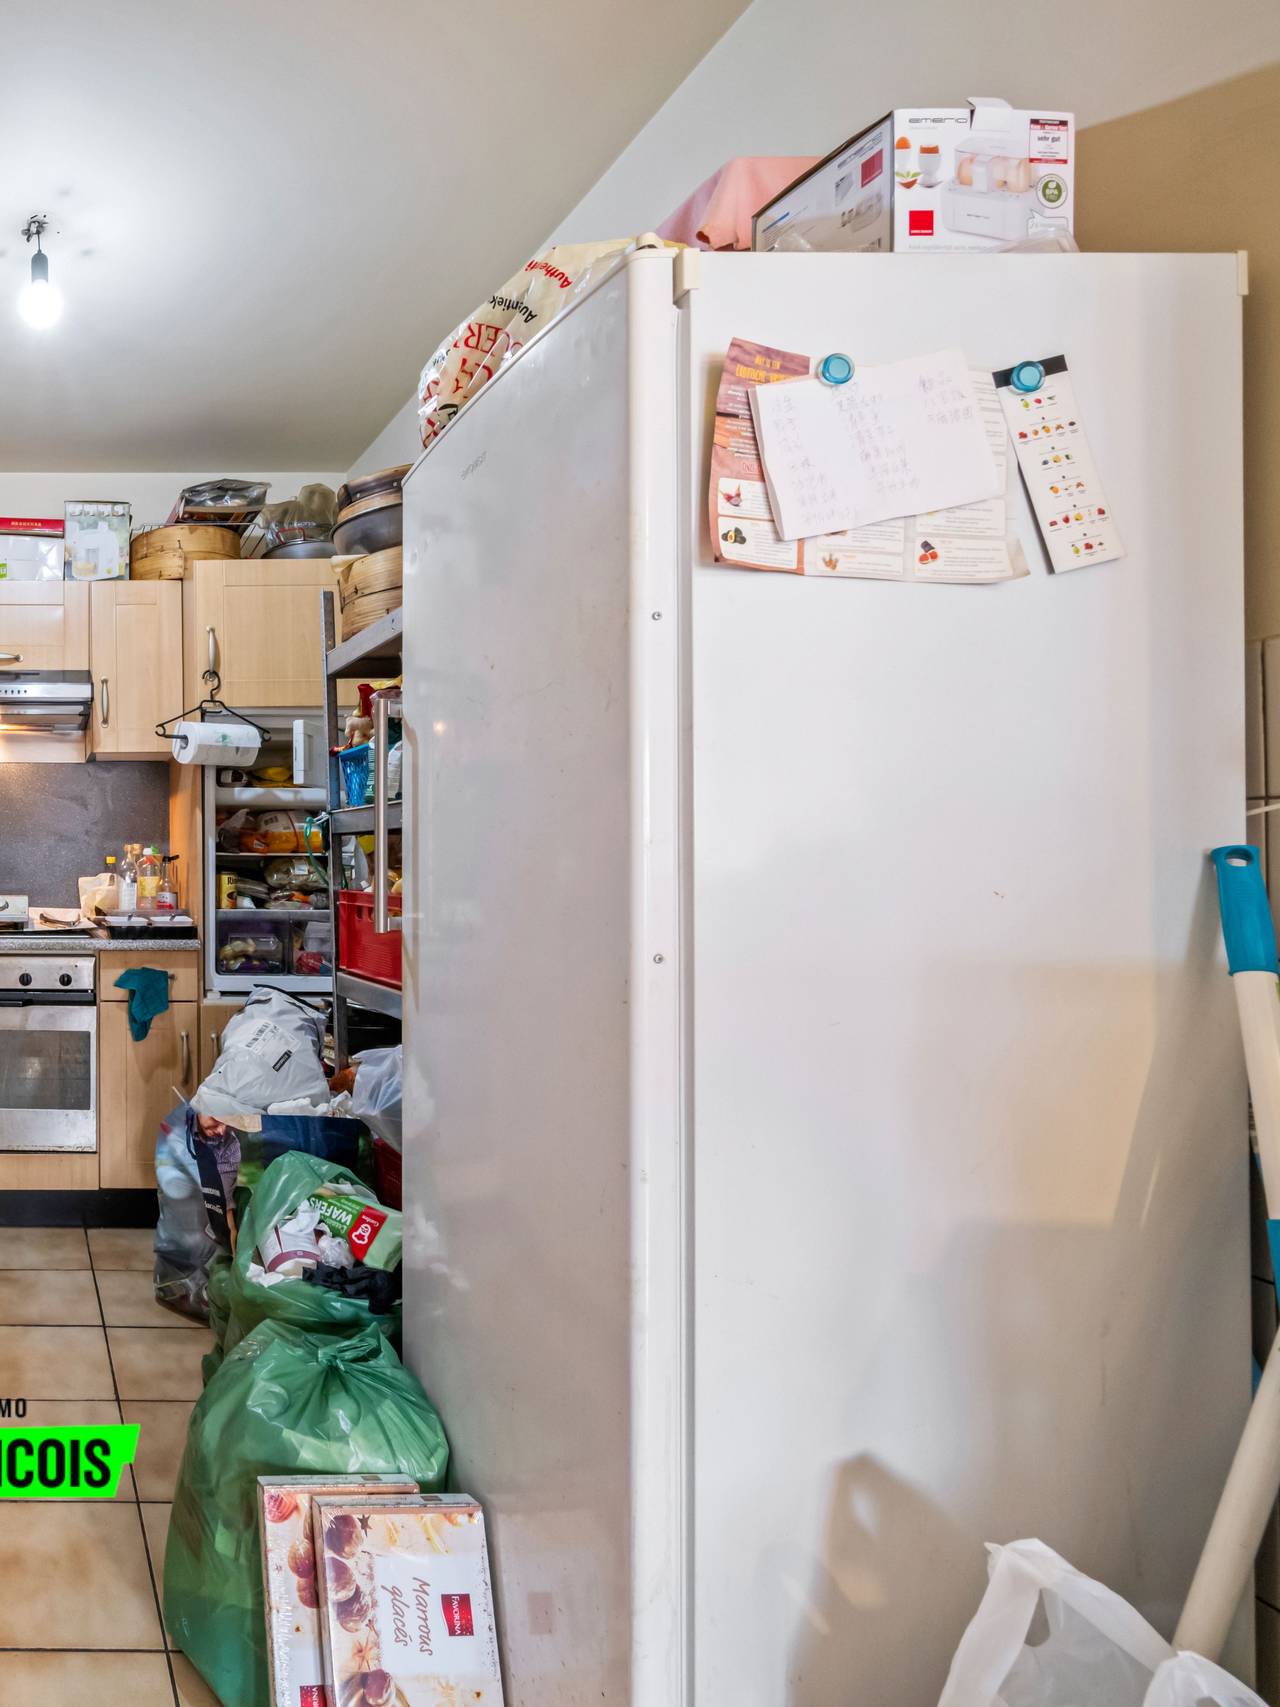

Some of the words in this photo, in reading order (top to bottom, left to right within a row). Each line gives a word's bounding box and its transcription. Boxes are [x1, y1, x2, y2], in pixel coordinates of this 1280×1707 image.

[309, 1197, 353, 1224] WAFERS
[380, 1585, 413, 1647] glacés
[451, 1595, 461, 1636] FAVORINA
